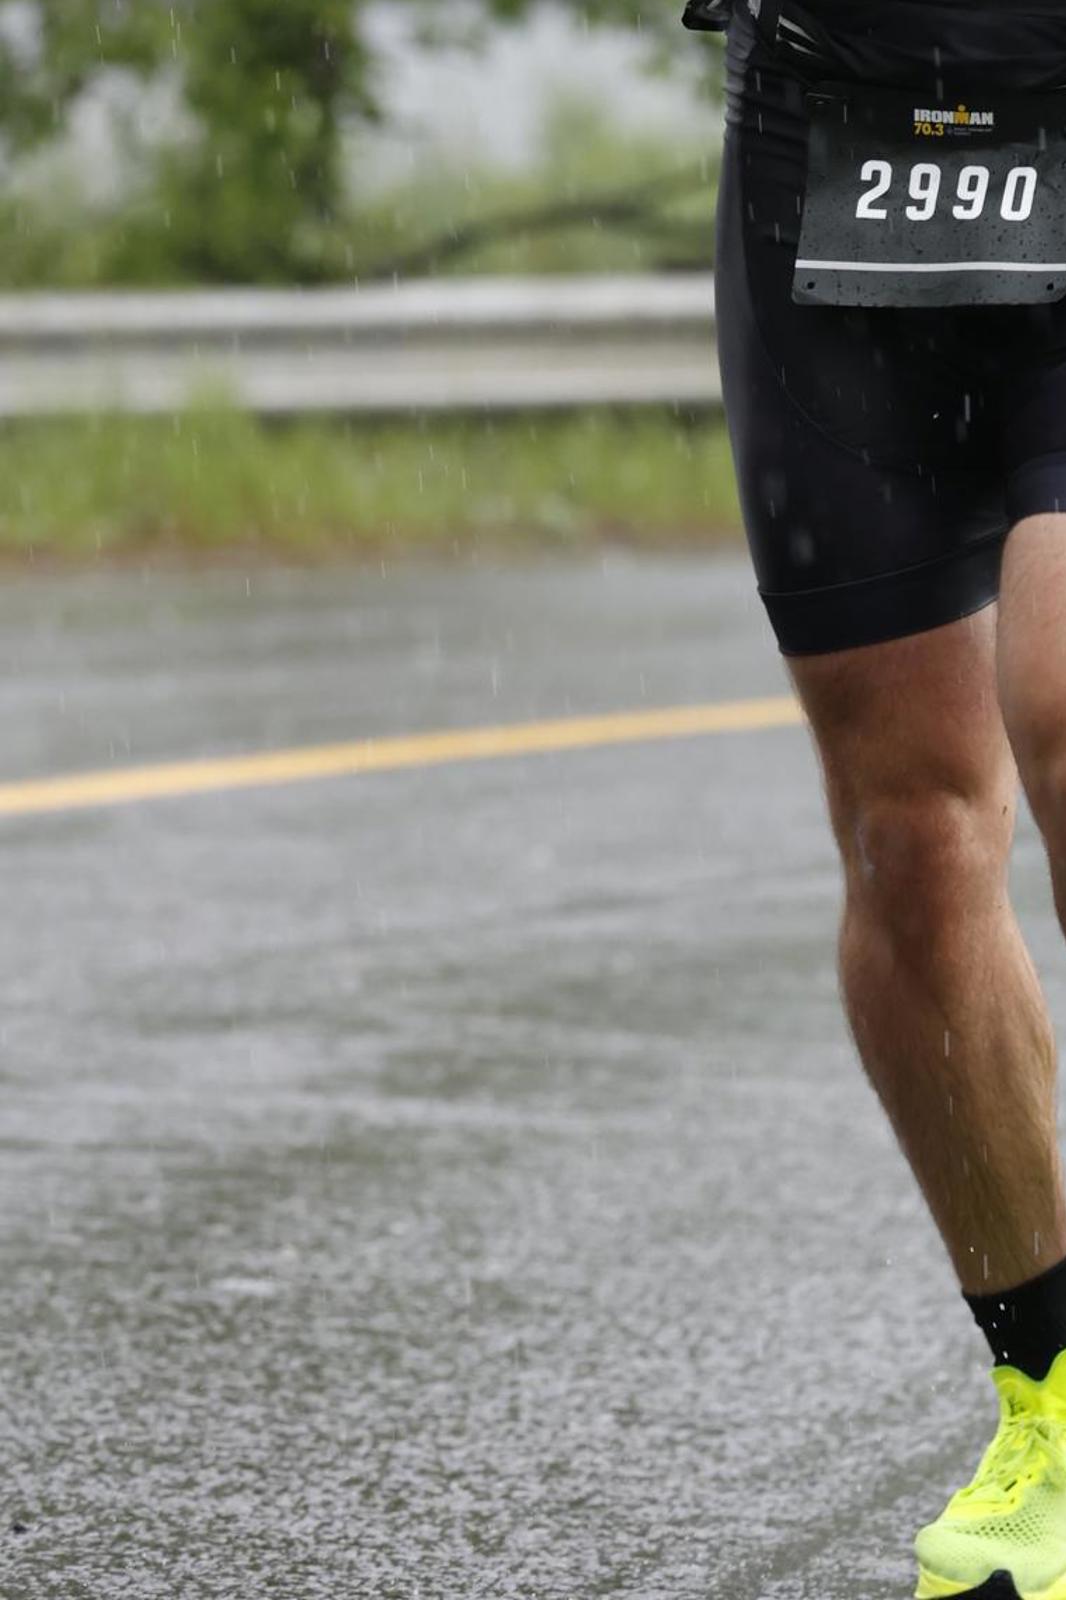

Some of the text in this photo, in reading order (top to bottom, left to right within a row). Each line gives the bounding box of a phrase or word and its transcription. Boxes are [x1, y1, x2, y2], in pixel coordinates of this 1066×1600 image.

[914, 104, 994, 125] IRONMAN
[914, 123, 944, 136] 70.3
[856, 160, 1037, 221] 2990
